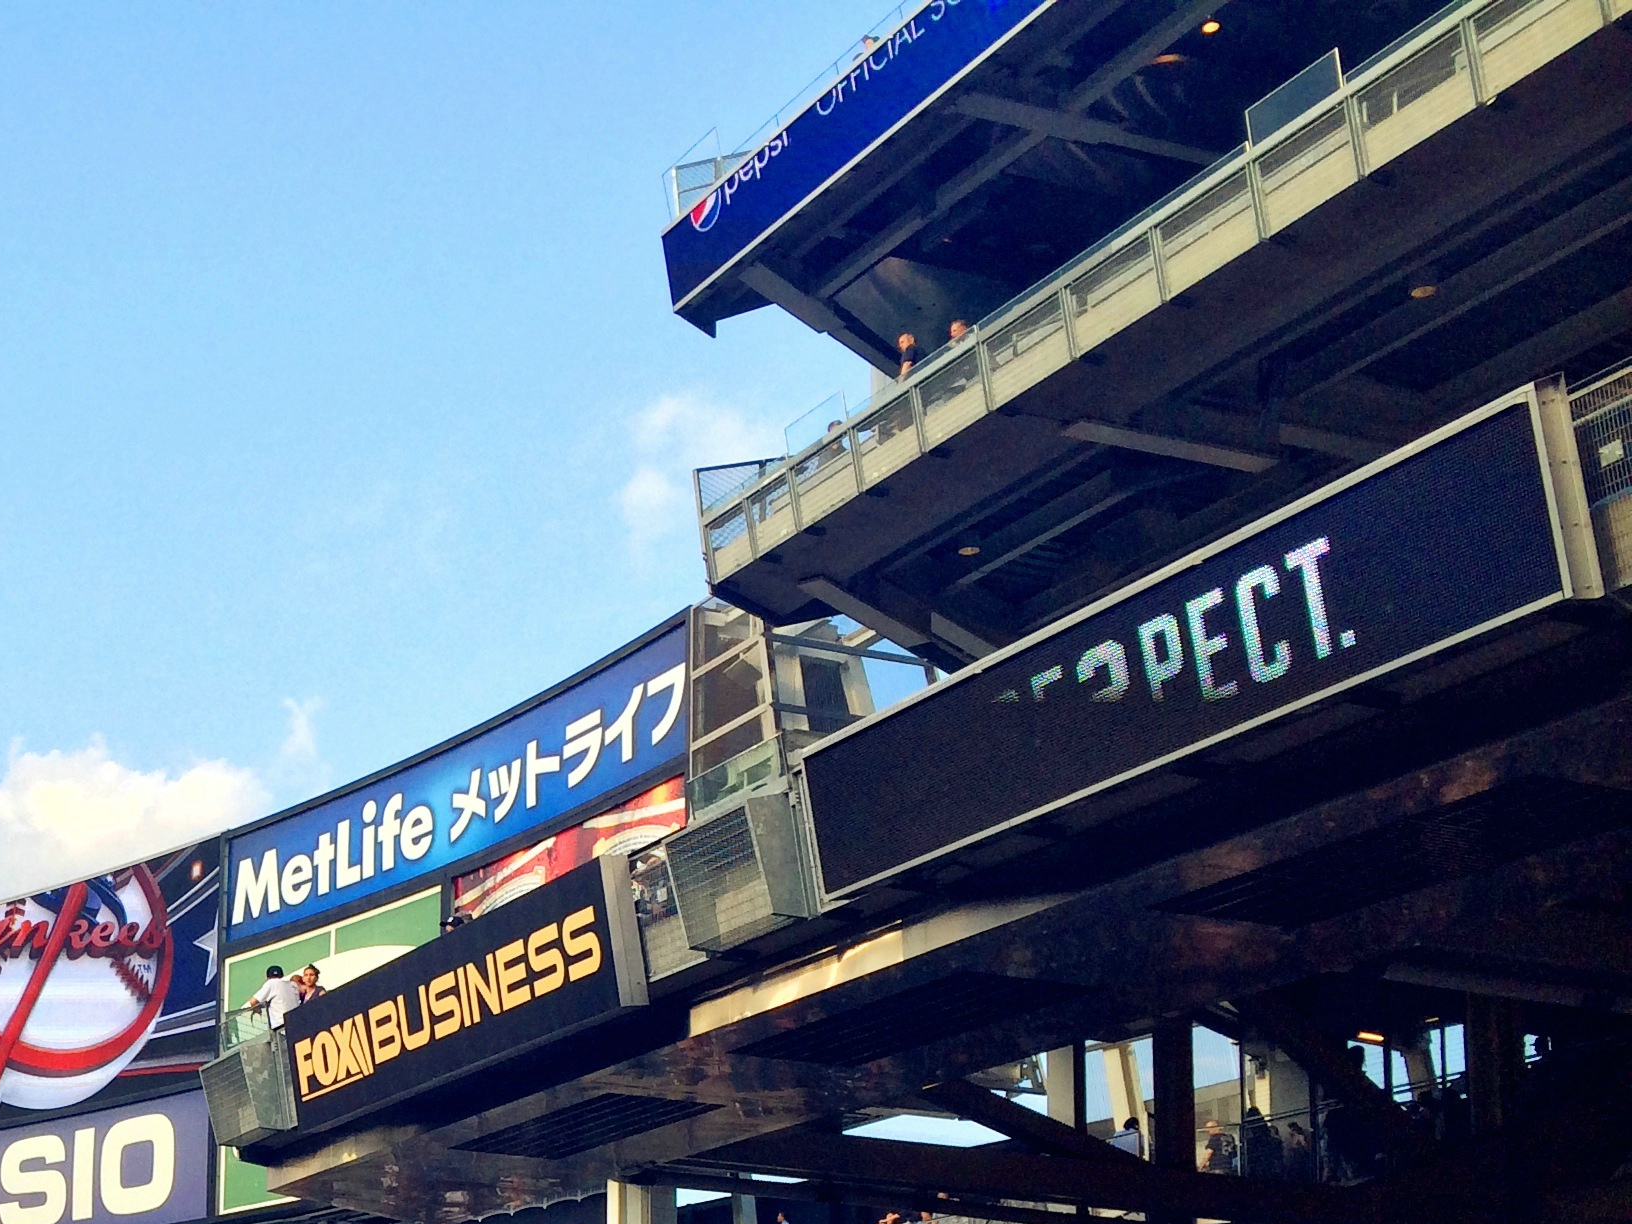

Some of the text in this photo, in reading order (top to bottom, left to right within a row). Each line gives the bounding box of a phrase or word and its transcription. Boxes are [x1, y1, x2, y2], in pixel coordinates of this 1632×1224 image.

[449, 661, 685, 843] メットライフ
[231, 788, 435, 925] MetLife
[294, 905, 602, 1097] FOX BUSINESS
